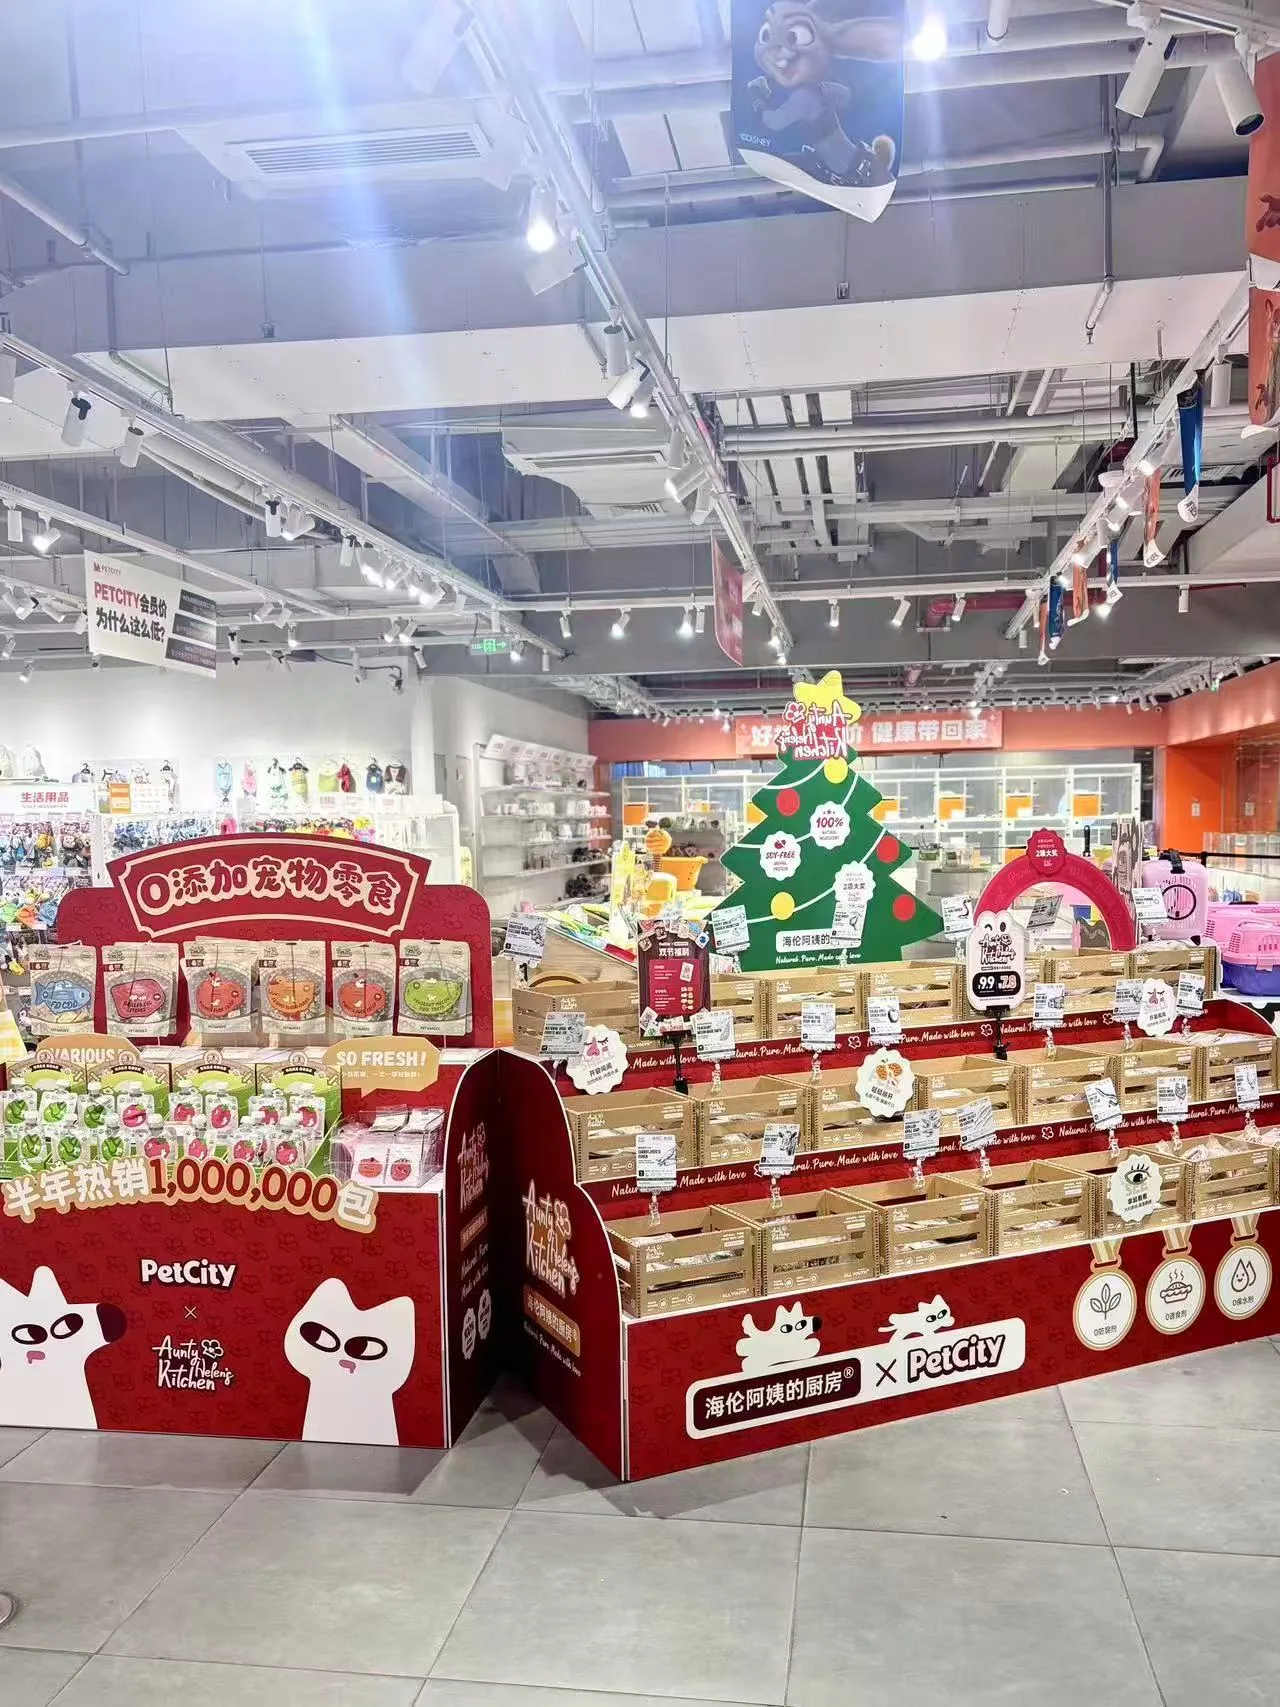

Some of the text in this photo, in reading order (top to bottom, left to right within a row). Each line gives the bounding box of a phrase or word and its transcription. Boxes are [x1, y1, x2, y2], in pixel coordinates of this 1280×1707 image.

[872, 719, 987, 745] 健康带回家
[21, 792, 69, 803] 生活用品
[816, 817, 844, 828] 100%
[765, 851, 795, 859] SOY-FREE
[782, 933, 832, 948] 海伦阿姨的
[659, 948, 690, 957] 双节福利
[1068, 1019, 1083, 1028] with
[1084, 1017, 1098, 1026] love
[943, 1030, 959, 1039] with
[960, 1030, 975, 1038] love
[336, 1051, 427, 1067] SO FRESH!
[659, 1054, 676, 1067] with
[679, 1055, 697, 1065] love
[1131, 1118, 1146, 1128] with
[1003, 1132, 1037, 1144] with love
[862, 1152, 881, 1163] with
[881, 1150, 898, 1160] love
[708, 1173, 727, 1184] with
[728, 1170, 748, 1181] love
[5, 1158, 374, 1227] 半年热销1,000,000包
[522, 1178, 554, 1240] Aunty
[526, 1219, 565, 1299] Kitchen
[141, 1258, 236, 1287] PetCity
[152, 1335, 201, 1365] Aunty
[908, 1334, 1005, 1383] PetCity
[158, 1360, 215, 1391] Kitchen
